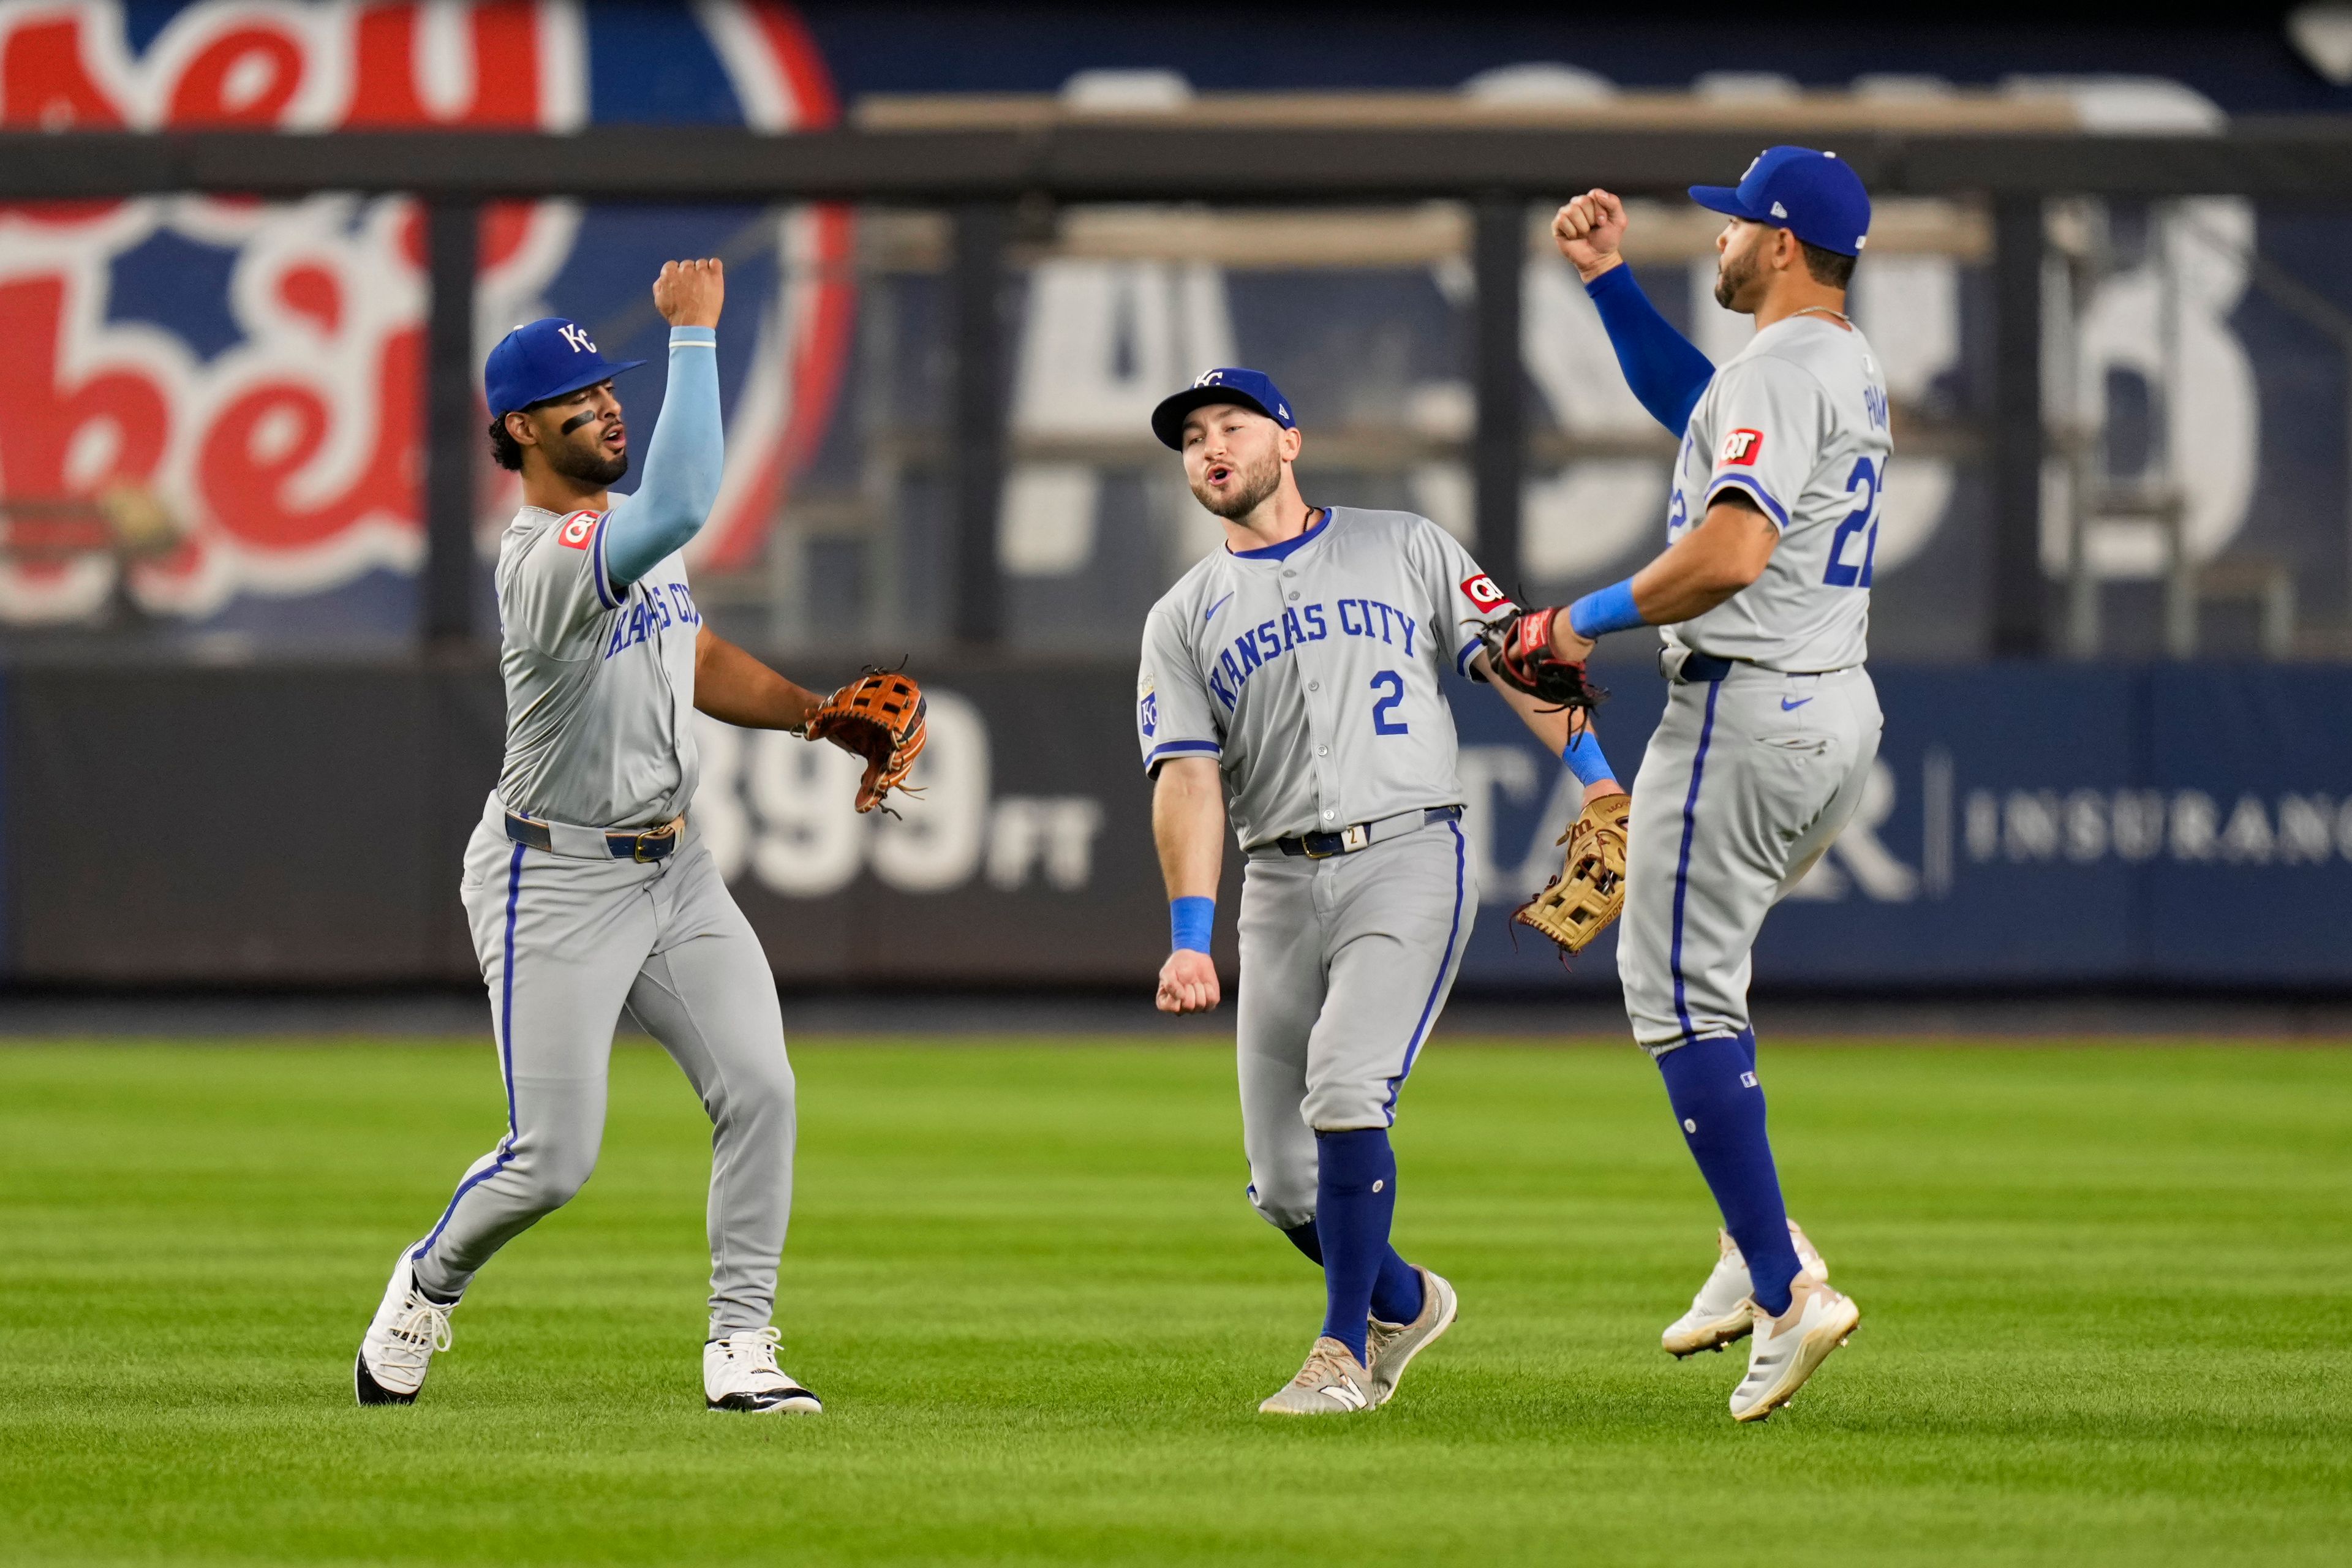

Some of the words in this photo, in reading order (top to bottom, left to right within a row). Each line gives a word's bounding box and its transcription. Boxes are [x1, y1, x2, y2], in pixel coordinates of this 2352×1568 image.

[558, 323, 597, 353] KC
[1720, 432, 1756, 461] QT
[1210, 603, 1327, 715] KANSAS
[1337, 599, 1416, 658] CITY
[1370, 669, 1408, 736] 2
[982, 795, 1096, 892] FT
